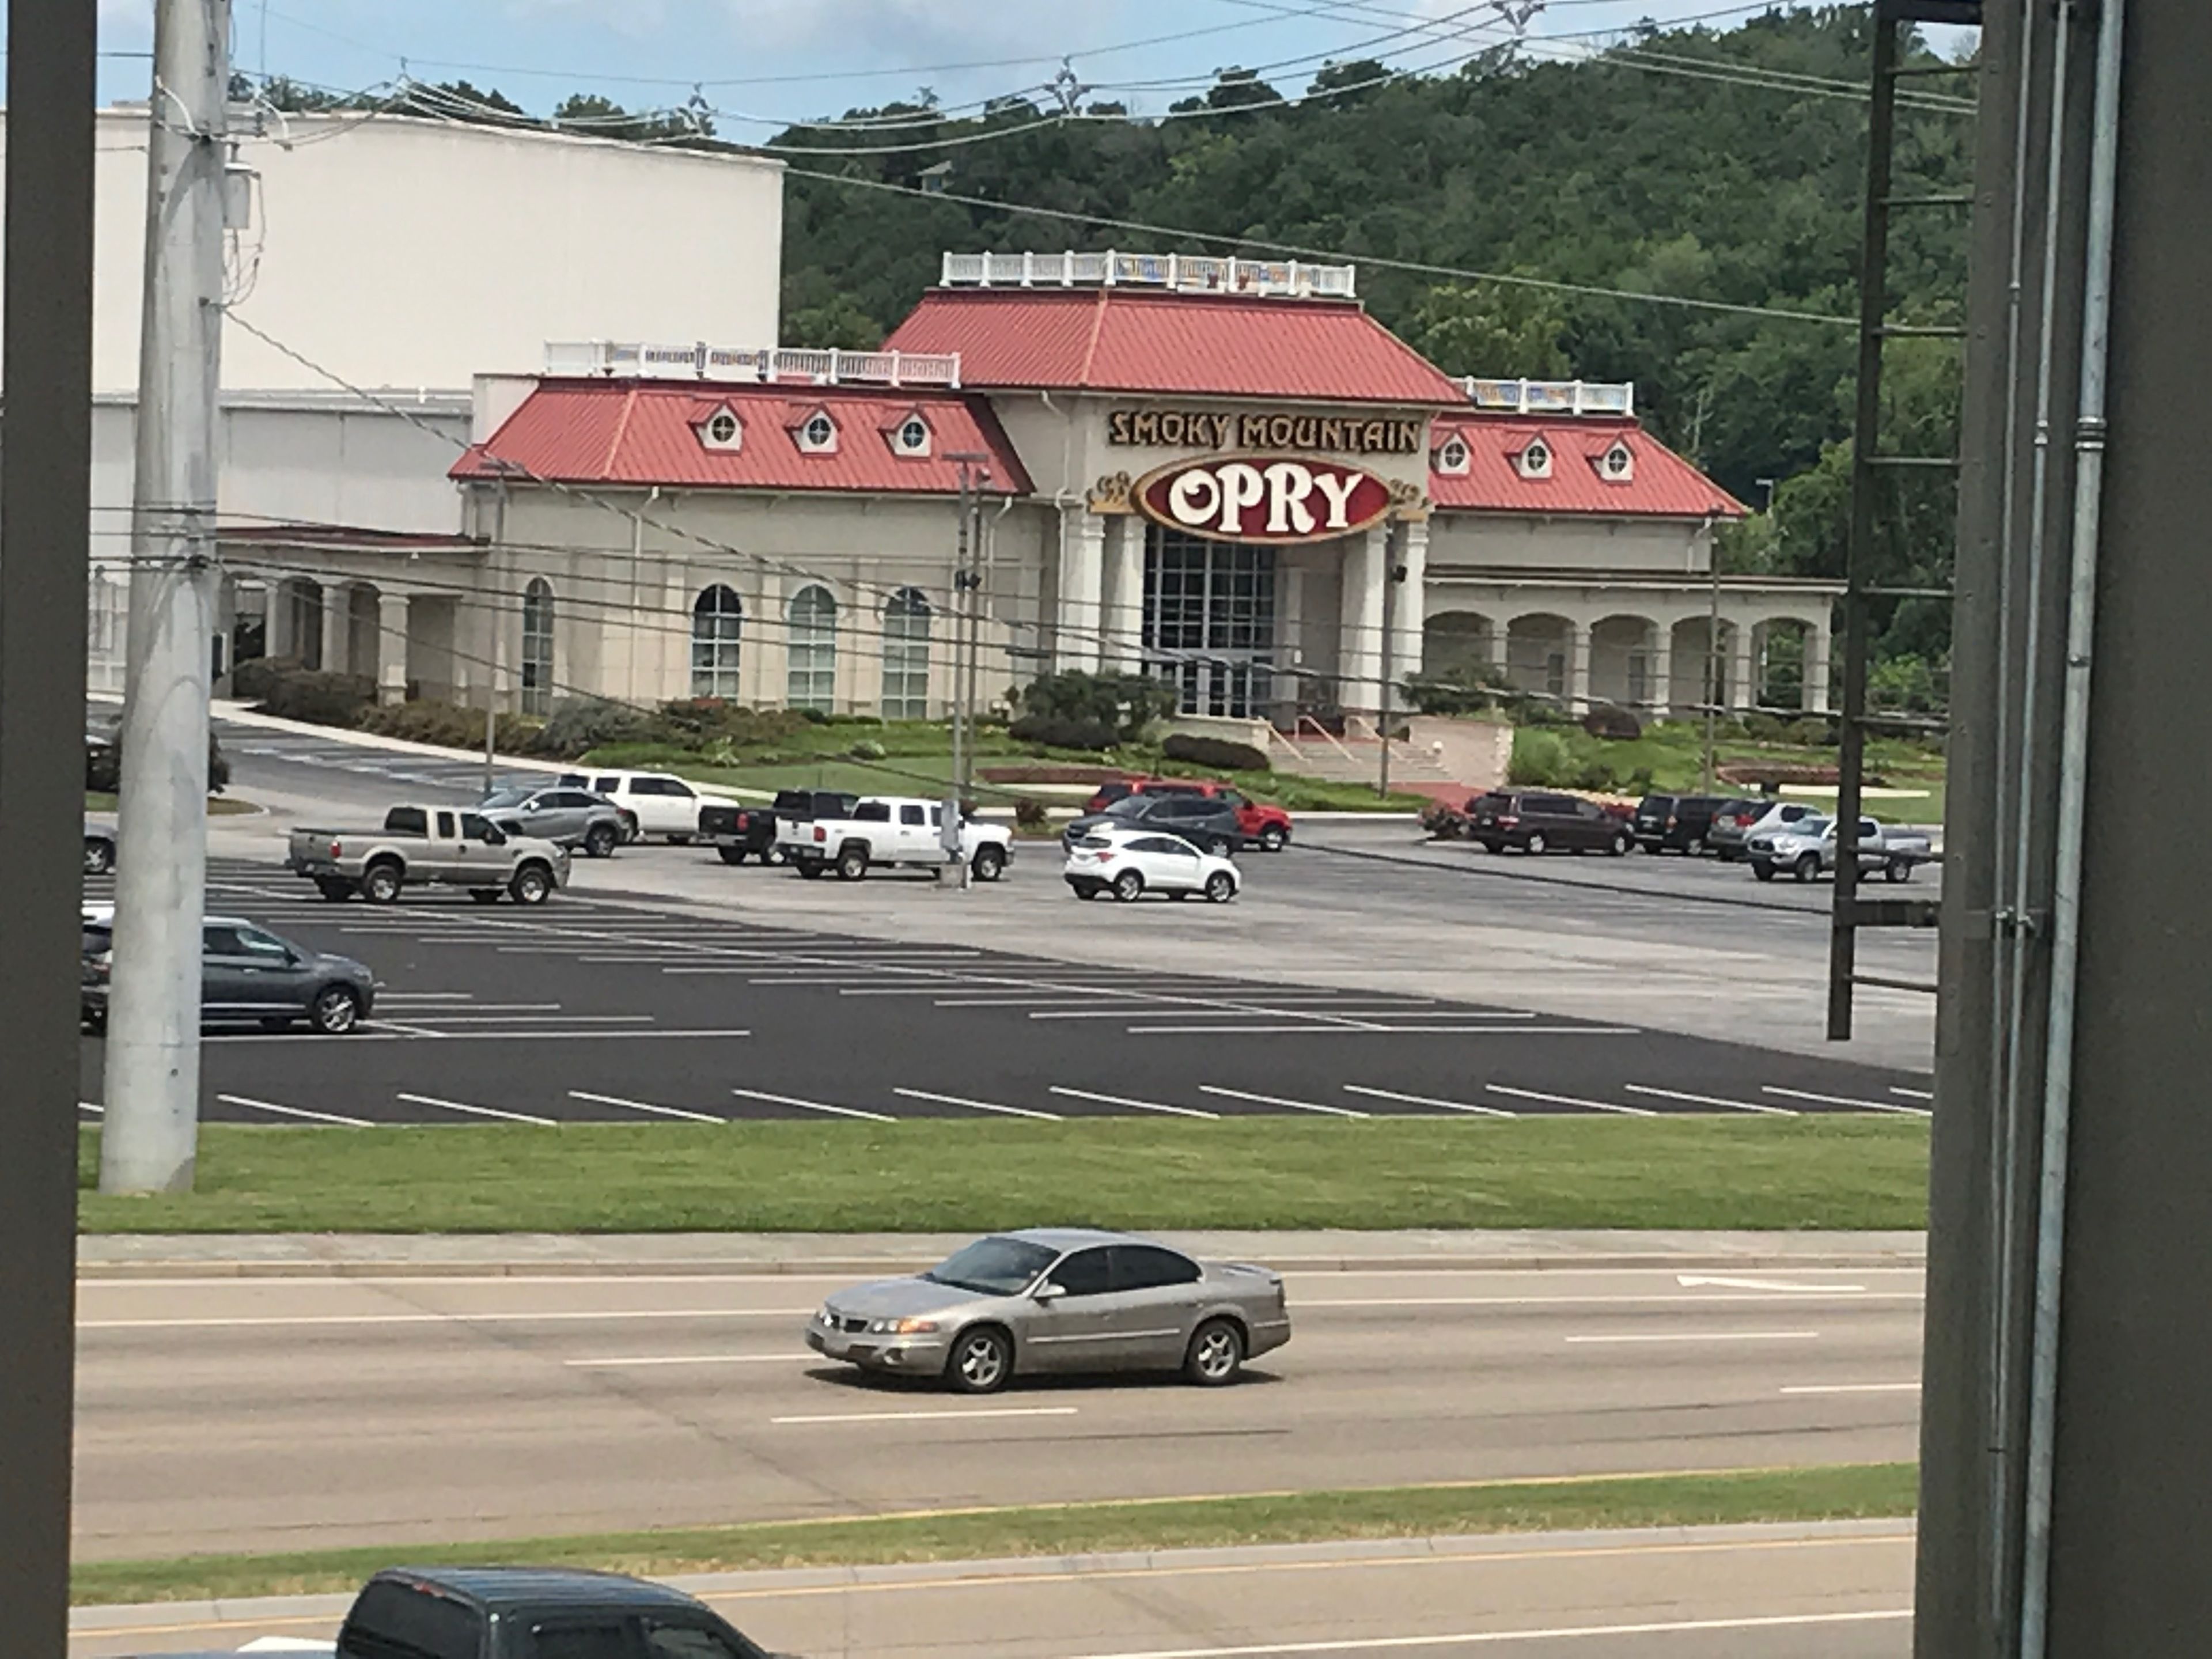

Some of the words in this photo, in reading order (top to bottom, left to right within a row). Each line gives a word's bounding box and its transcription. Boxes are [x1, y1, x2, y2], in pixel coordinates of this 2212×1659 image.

[1109, 411, 1230, 448] SMOKY
[1238, 414, 1421, 453] MOUNTAIN
[1169, 463, 1363, 533] OPRY
